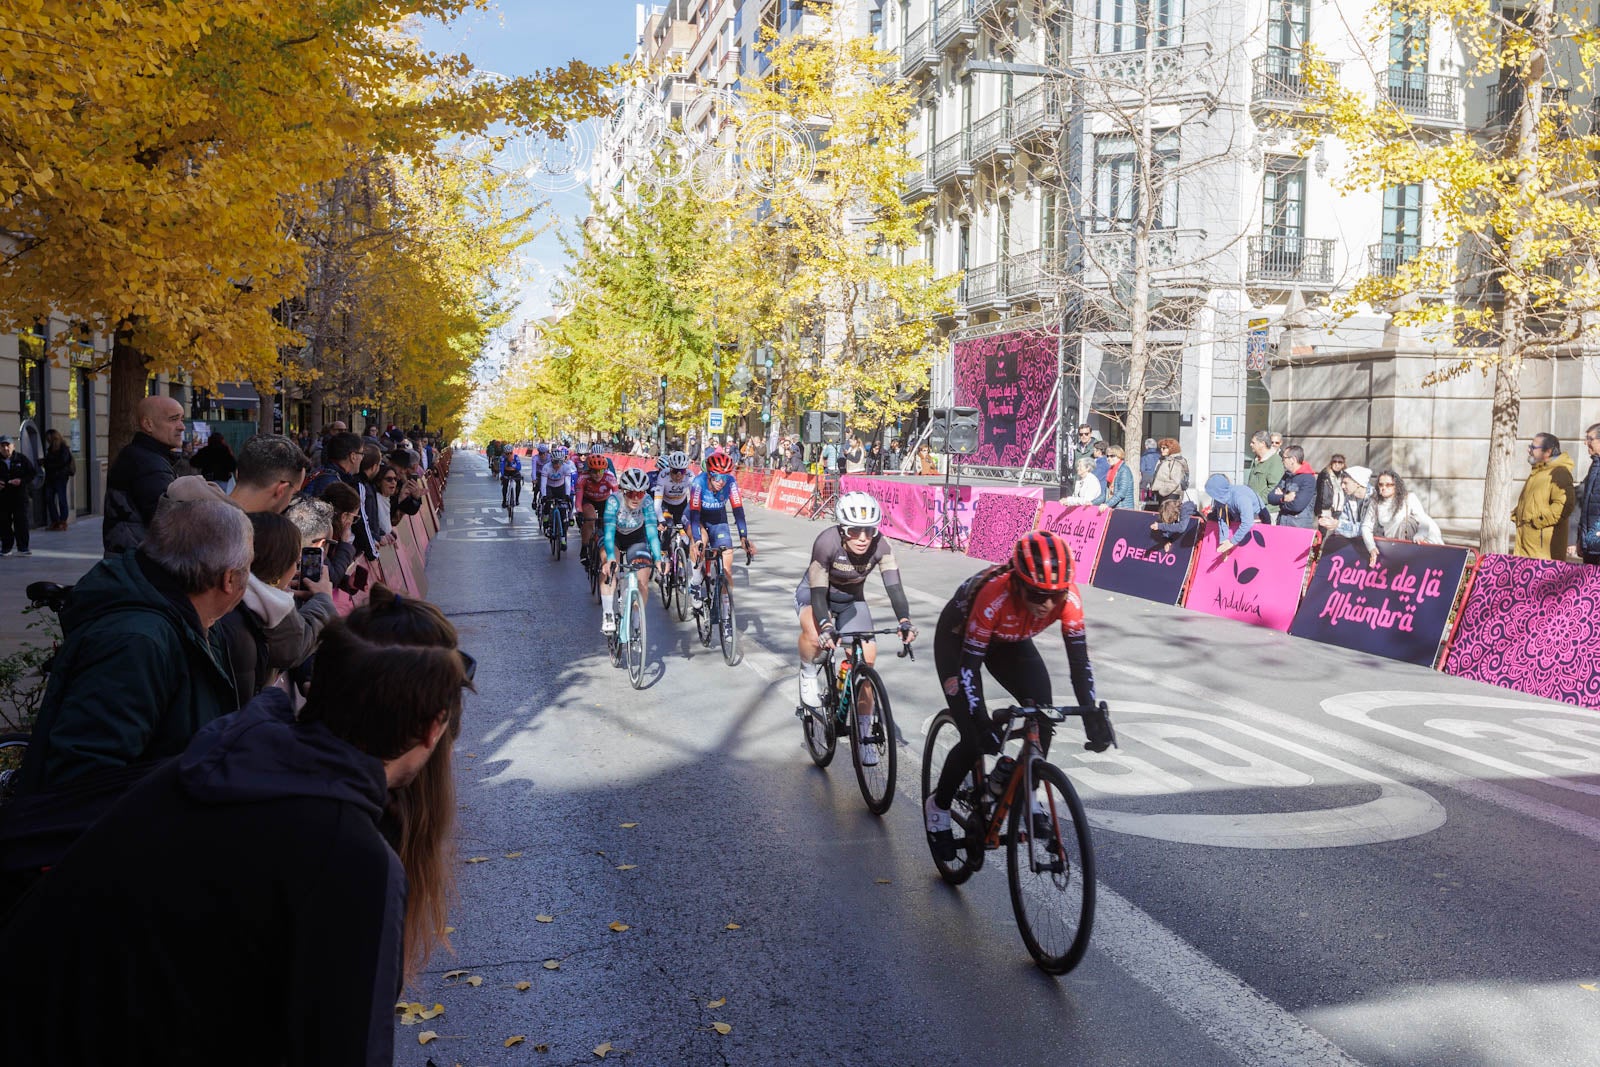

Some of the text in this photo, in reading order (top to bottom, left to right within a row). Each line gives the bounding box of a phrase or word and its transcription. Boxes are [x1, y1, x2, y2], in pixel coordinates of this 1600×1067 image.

[1220, 418, 1228, 430] H
[1073, 520, 1085, 537] de
[1126, 546, 1176, 566] RELEVO
[1391, 564, 1417, 593] de
